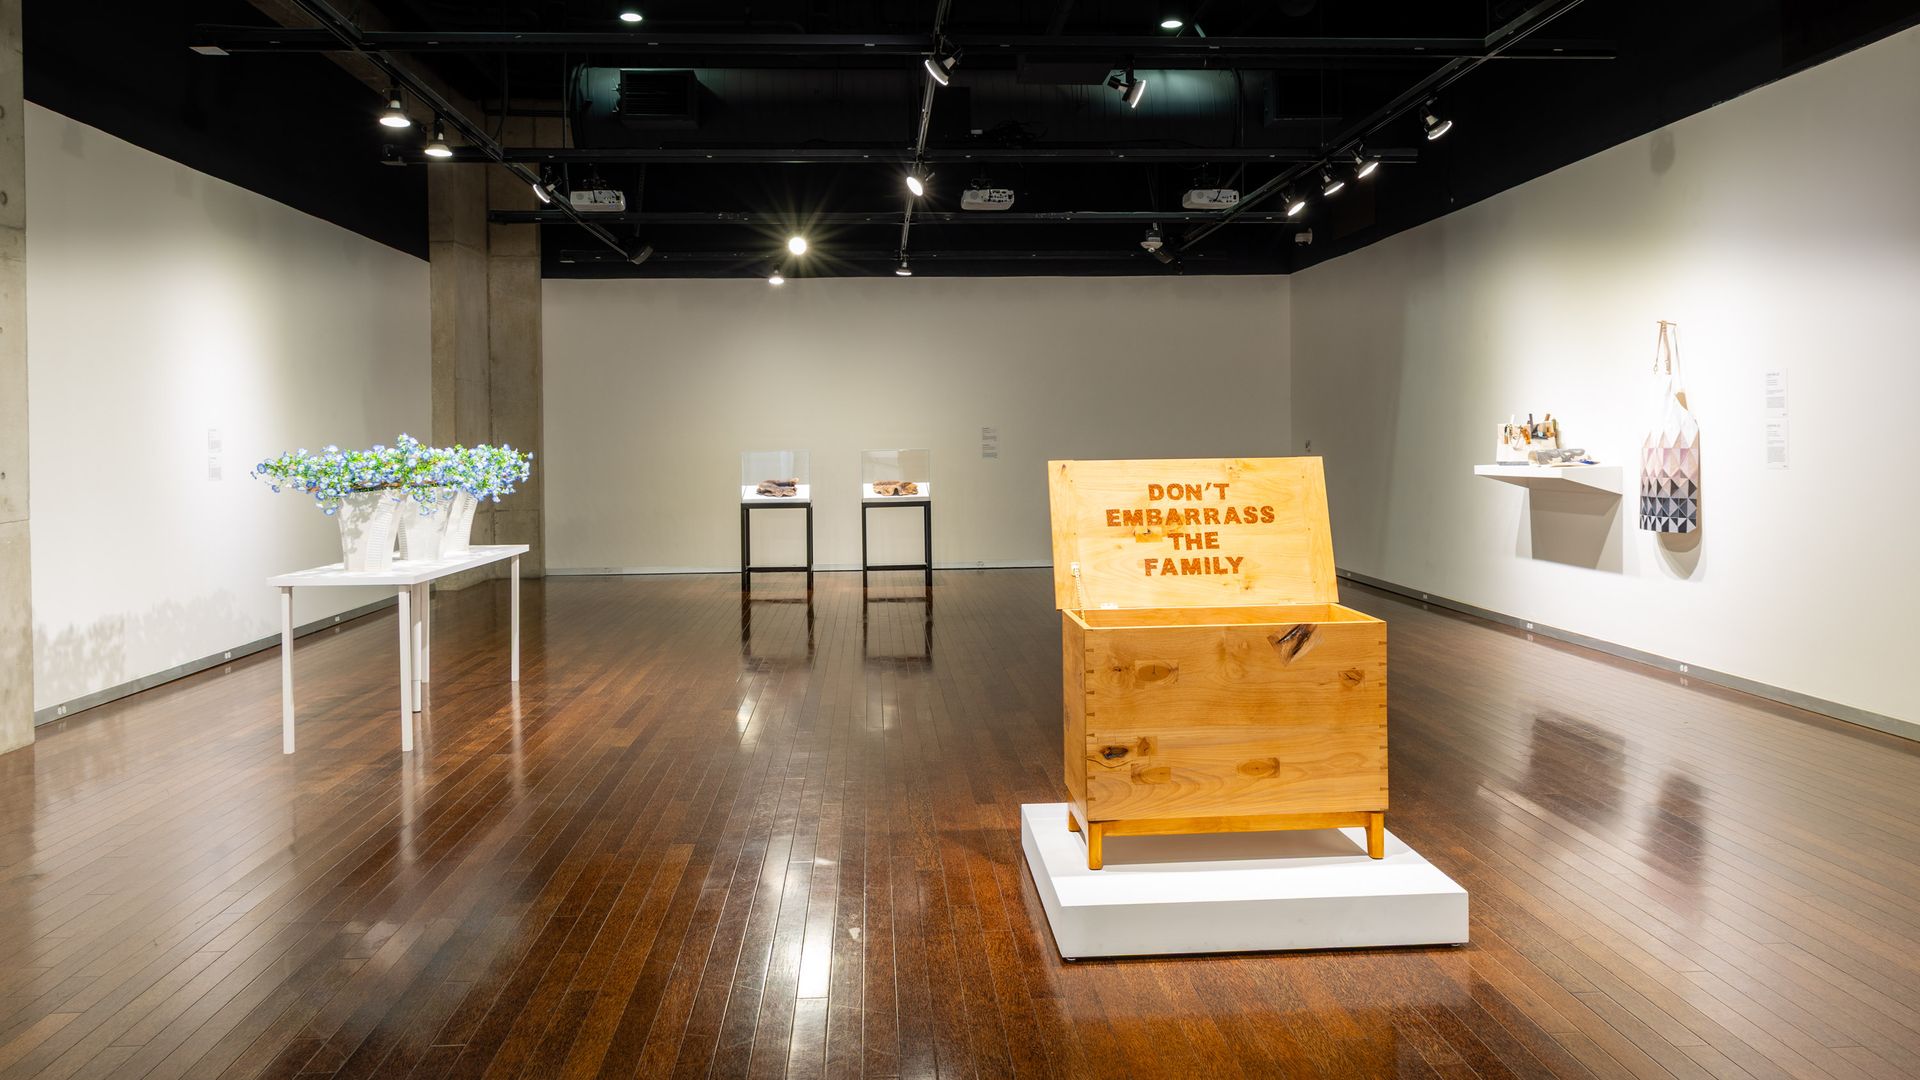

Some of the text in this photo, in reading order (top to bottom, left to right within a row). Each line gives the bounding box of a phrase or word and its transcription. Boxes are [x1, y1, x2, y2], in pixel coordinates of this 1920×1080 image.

[1148, 482, 1229, 501] DON'T
[1106, 506, 1275, 527] EMBARRASS
[1168, 532, 1220, 550] THE
[1144, 557, 1244, 576] FAMILY
